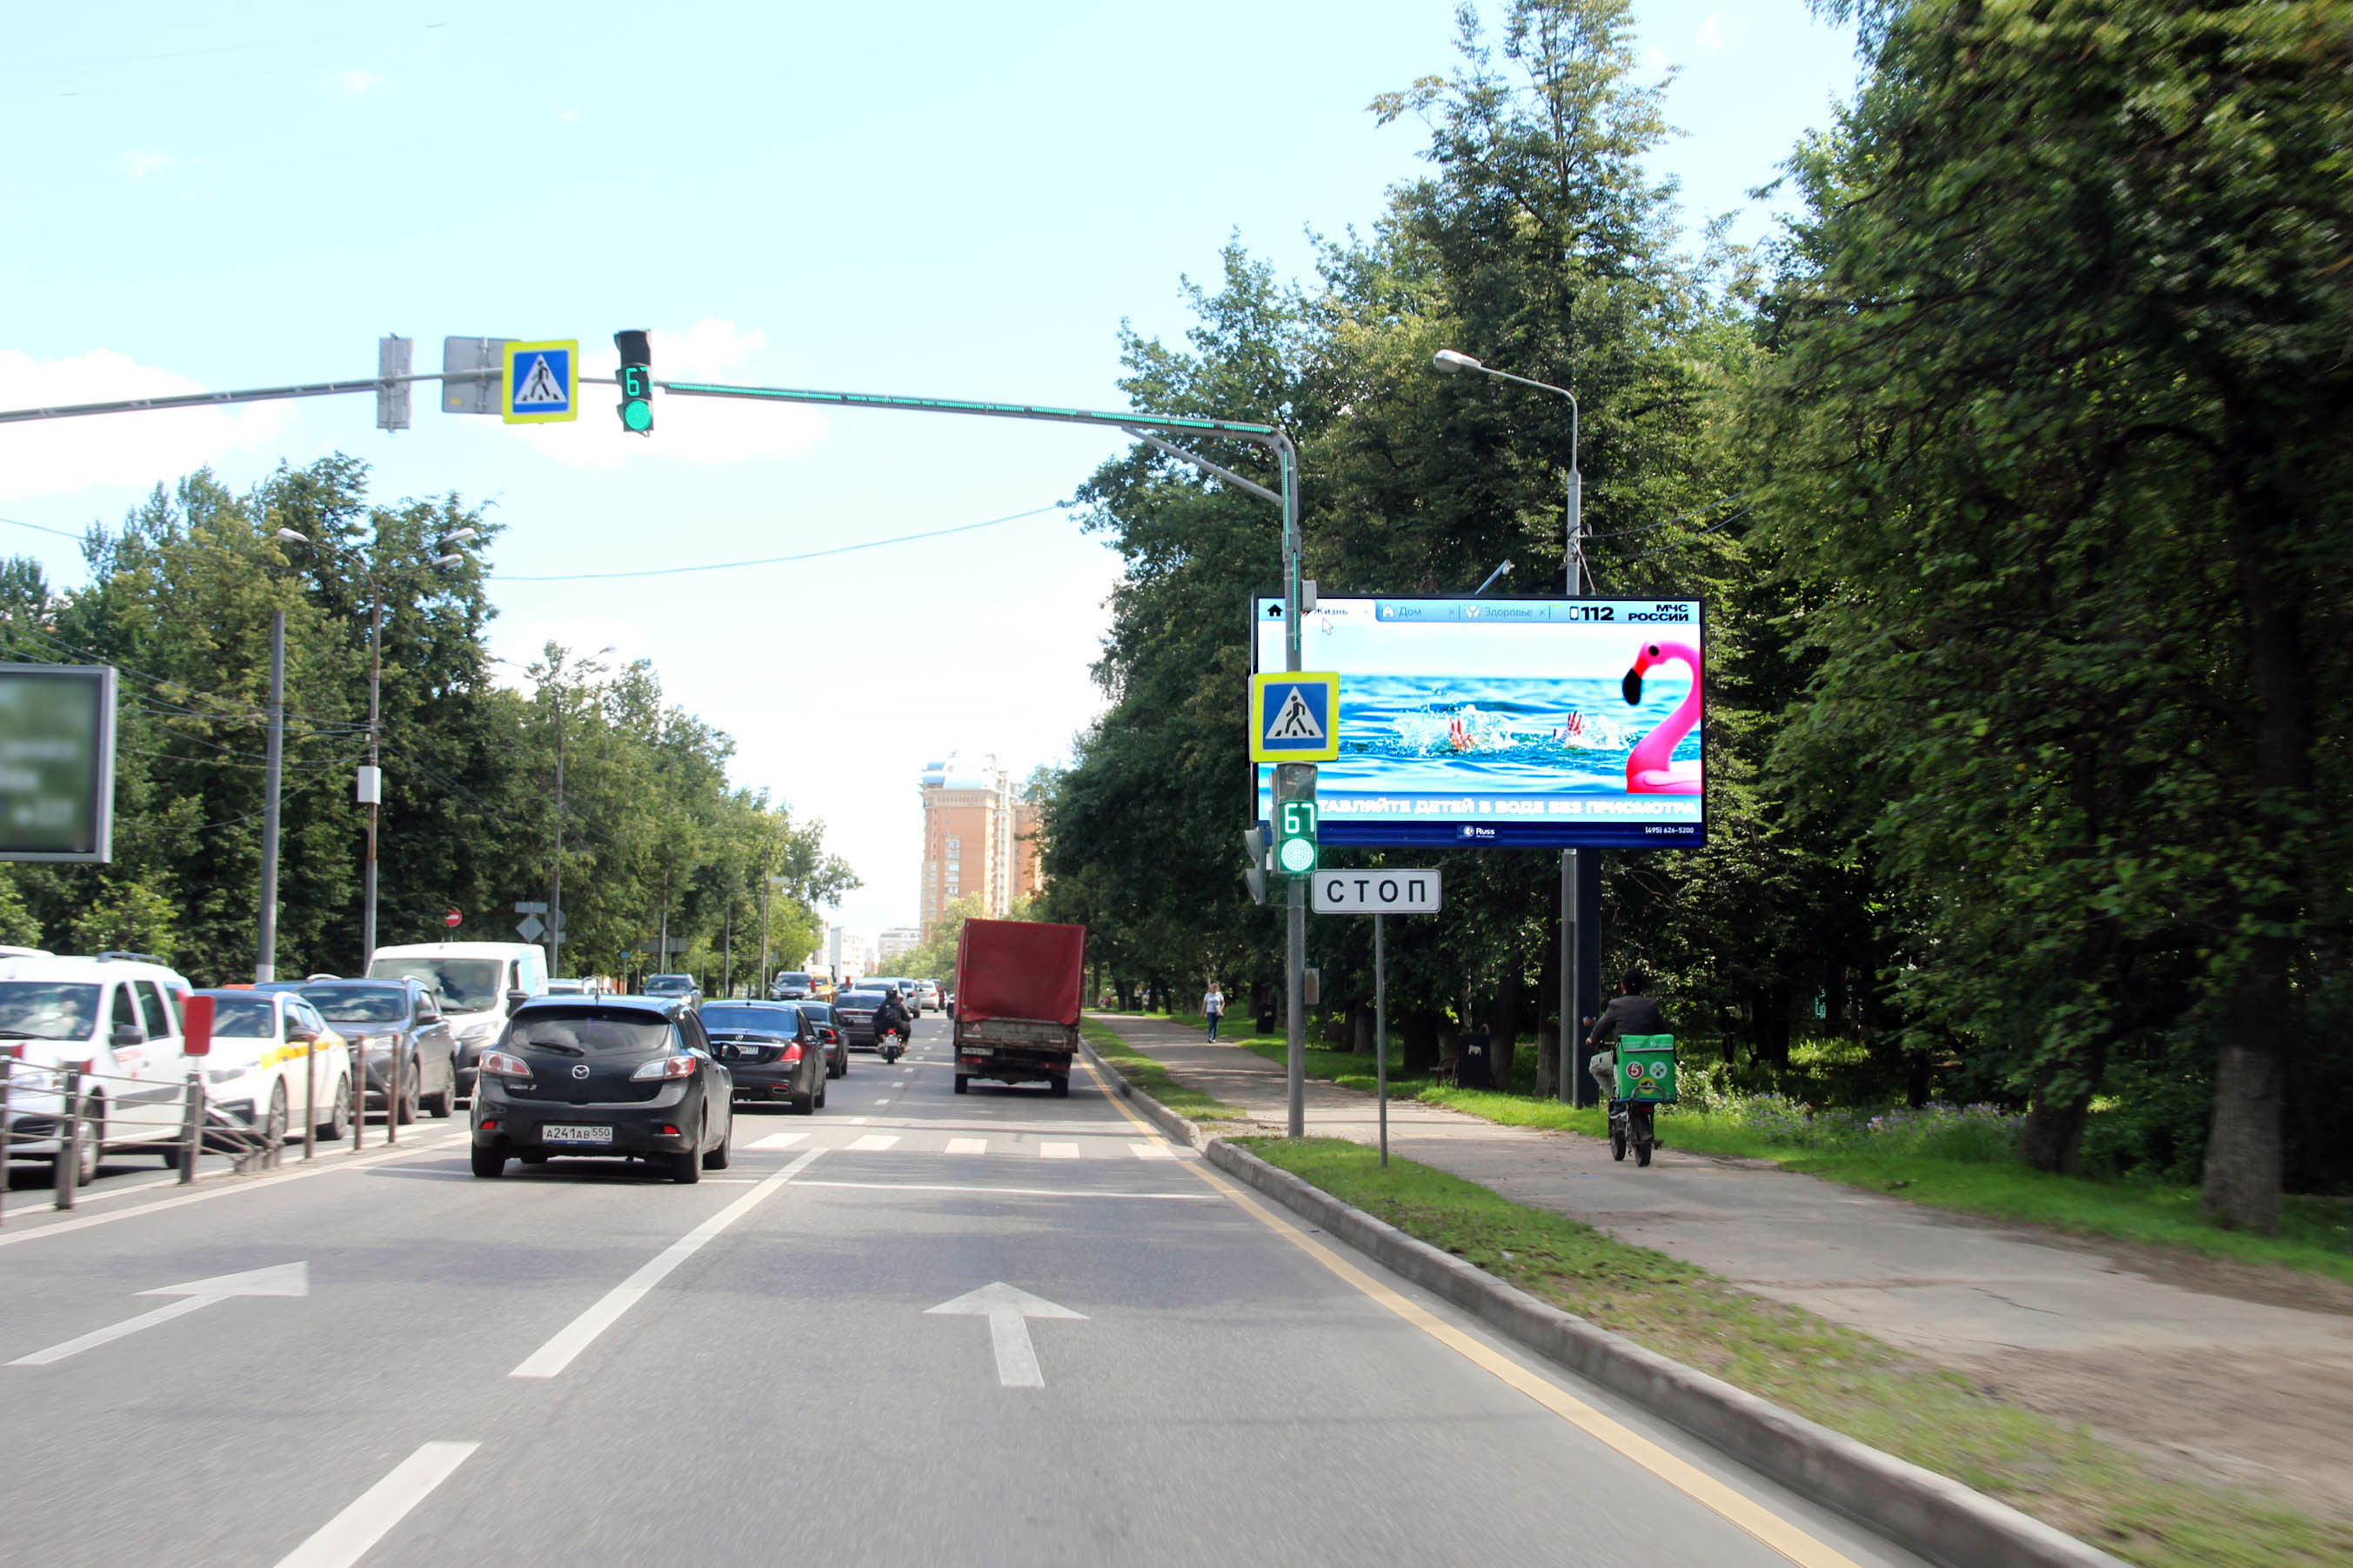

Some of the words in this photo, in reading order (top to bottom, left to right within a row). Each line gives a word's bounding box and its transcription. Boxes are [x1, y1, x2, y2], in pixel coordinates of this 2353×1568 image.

[1398, 606, 1421, 617] Дом
[1484, 607, 1533, 618] Здоровье
[1581, 607, 1614, 621] 112
[1317, 798, 1411, 814] ТАВЛЯЙТЕ
[1414, 797, 1474, 815] ДЕТЕЙ
[1480, 800, 1492, 813] В
[1495, 800, 1545, 815] ВОДЕ
[1548, 800, 1582, 814] БЕЗ
[1586, 801, 1697, 815] ПРИСМОТРА
[1284, 804, 1315, 834] 67
[1327, 880, 1425, 903] СТОП
